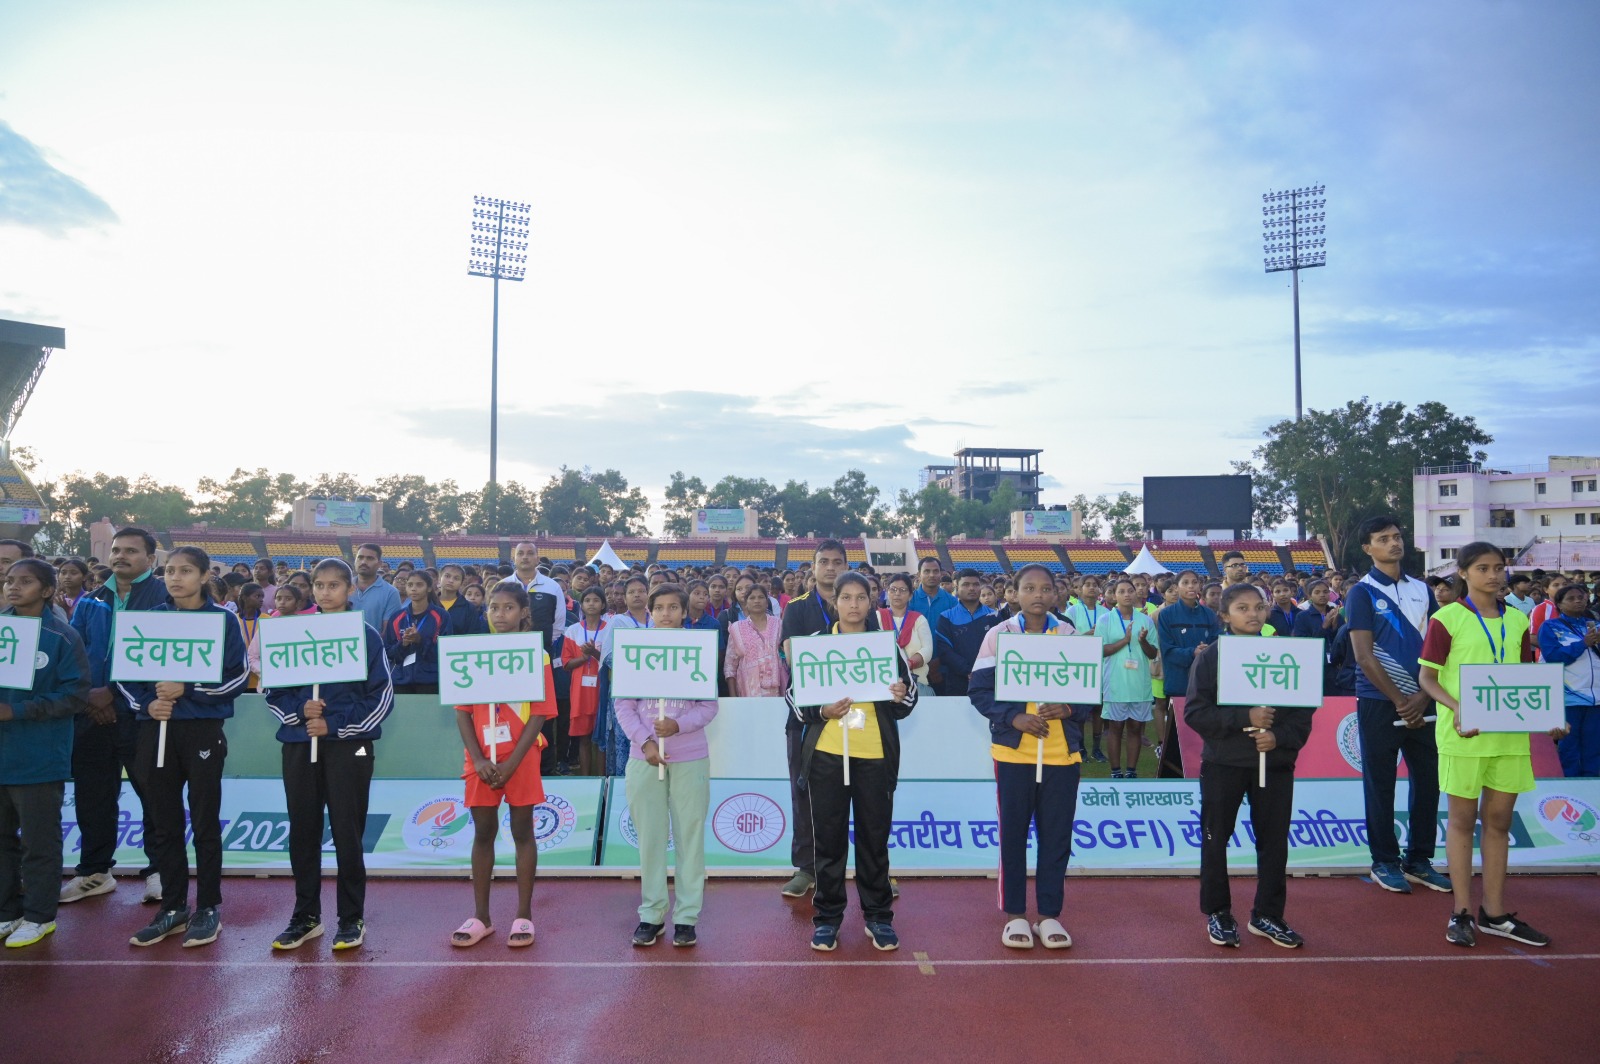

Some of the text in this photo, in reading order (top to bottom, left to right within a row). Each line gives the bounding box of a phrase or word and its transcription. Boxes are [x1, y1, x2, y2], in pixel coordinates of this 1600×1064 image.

[122, 625, 215, 668] देवघर
[265, 630, 359, 669] लातेहार
[622, 645, 707, 682] पलामू
[446, 648, 535, 688] दुमका
[796, 647, 893, 688] गिरिडीह
[1001, 650, 1098, 688] सिमडेगा
[1242, 653, 1300, 690] राँची
[1472, 675, 1552, 721] गोड्डा
[1081, 787, 1120, 807] खेलो
[1124, 791, 1194, 809] झारखण्ड
[736, 812, 764, 834] SGFI
[1070, 819, 1175, 857] SGFI)
